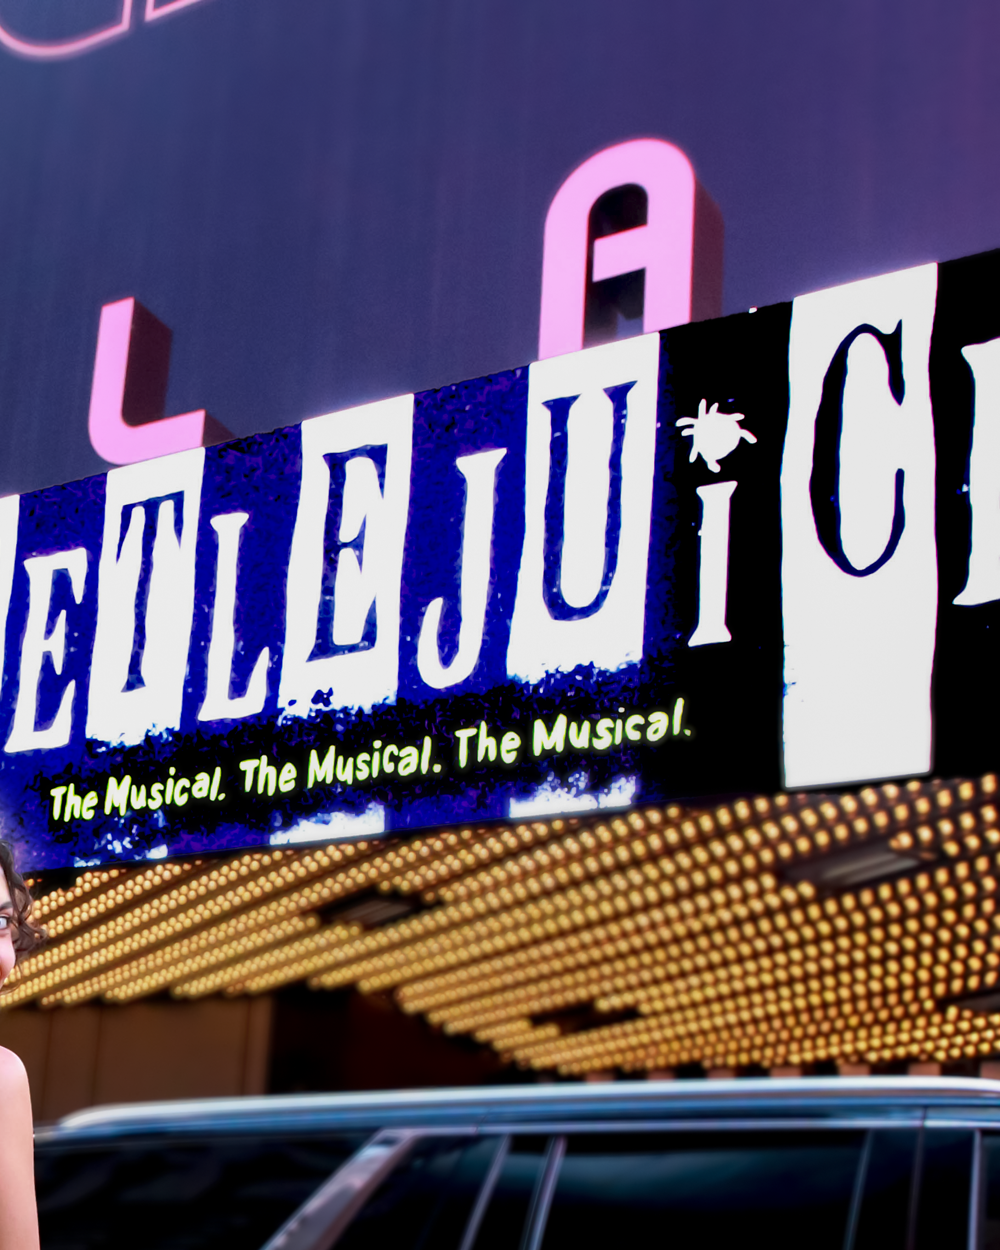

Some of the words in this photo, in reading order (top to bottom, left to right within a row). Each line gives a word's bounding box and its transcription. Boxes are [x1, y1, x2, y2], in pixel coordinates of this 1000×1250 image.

[50, 783, 98, 822] The
[104, 766, 226, 816] Musical.
[239, 755, 297, 797] The
[307, 736, 442, 789] Musical.
[455, 720, 521, 769] The
[533, 697, 692, 757] Musical.
